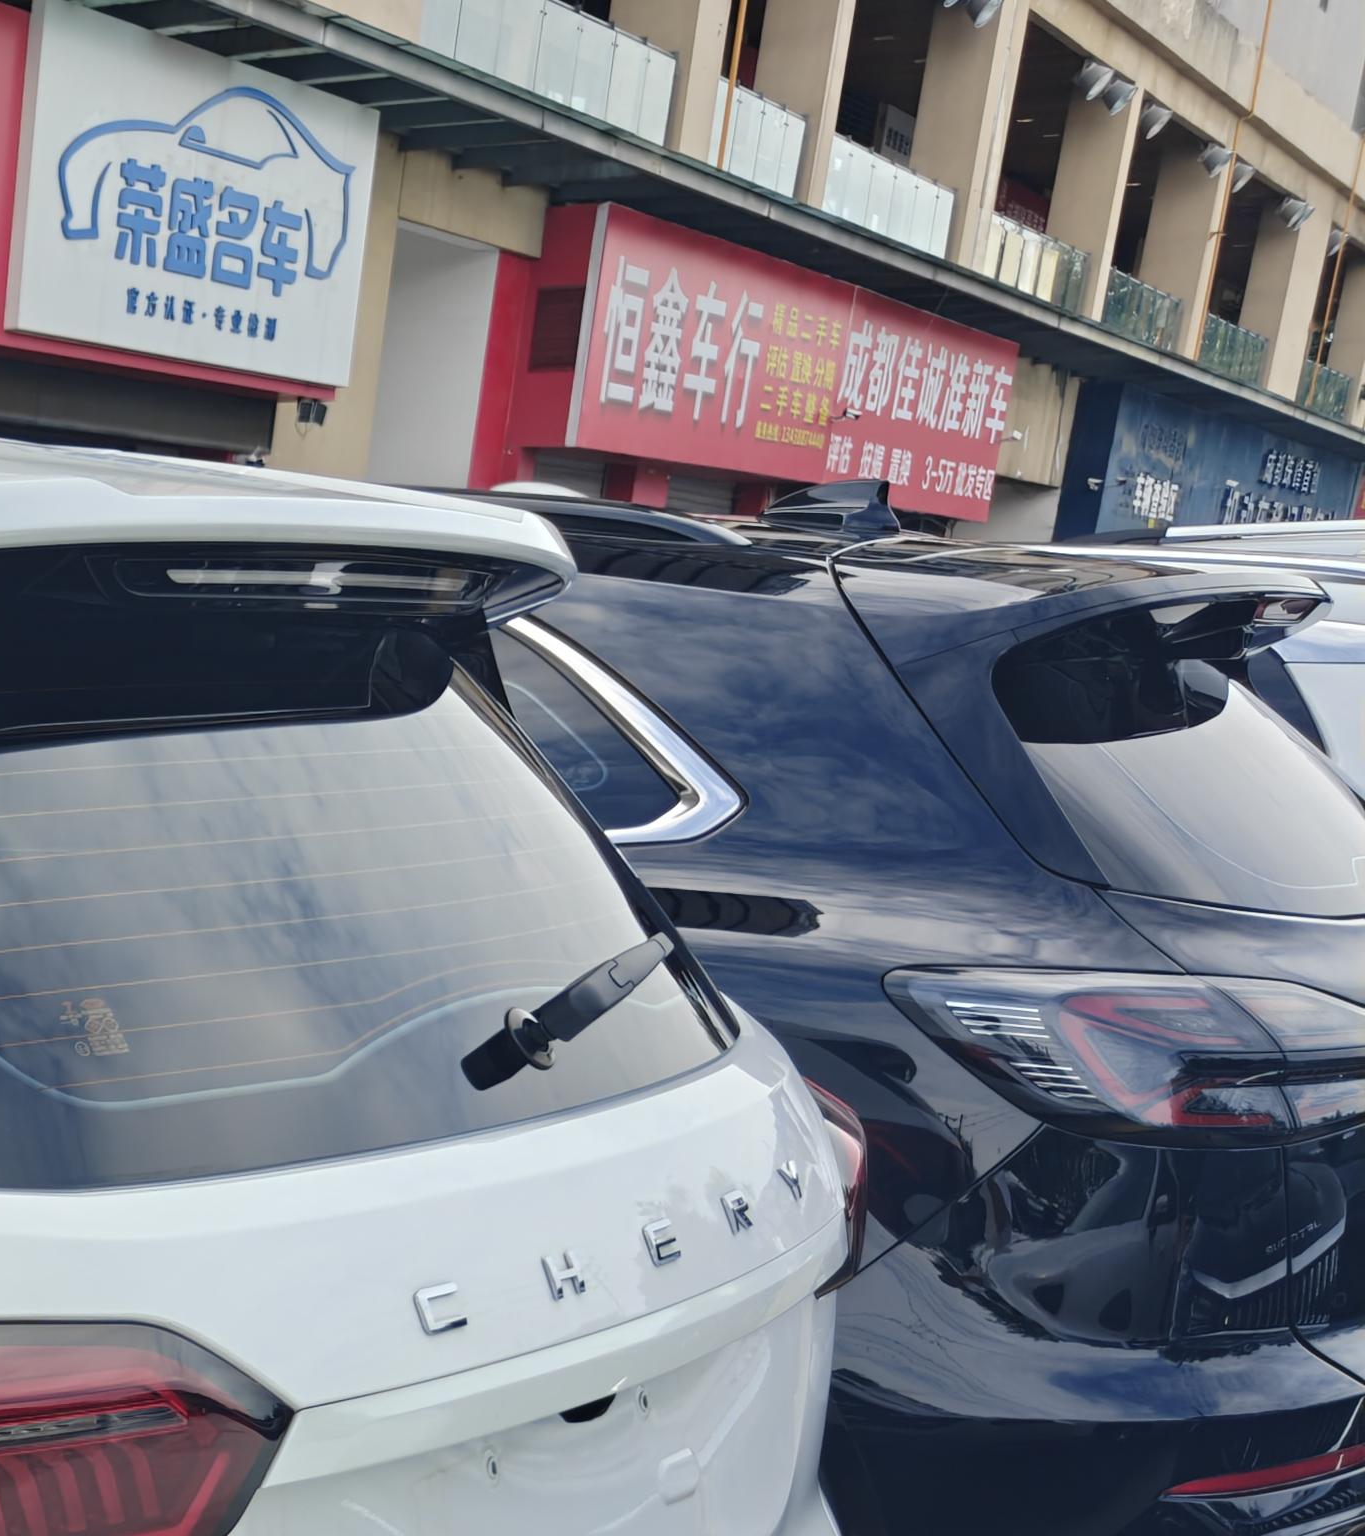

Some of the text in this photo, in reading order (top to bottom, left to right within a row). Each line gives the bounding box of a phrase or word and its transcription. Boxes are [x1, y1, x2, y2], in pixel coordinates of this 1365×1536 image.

[114, 158, 308, 297] 荣盛名车
[600, 255, 763, 428] 恒鑫车行
[772, 303, 842, 349] 精品二手车
[837, 320, 1013, 445] 成都佳诚准新车
[826, 433, 853, 474] 评估
[413, 1159, 804, 1336] CHERY
